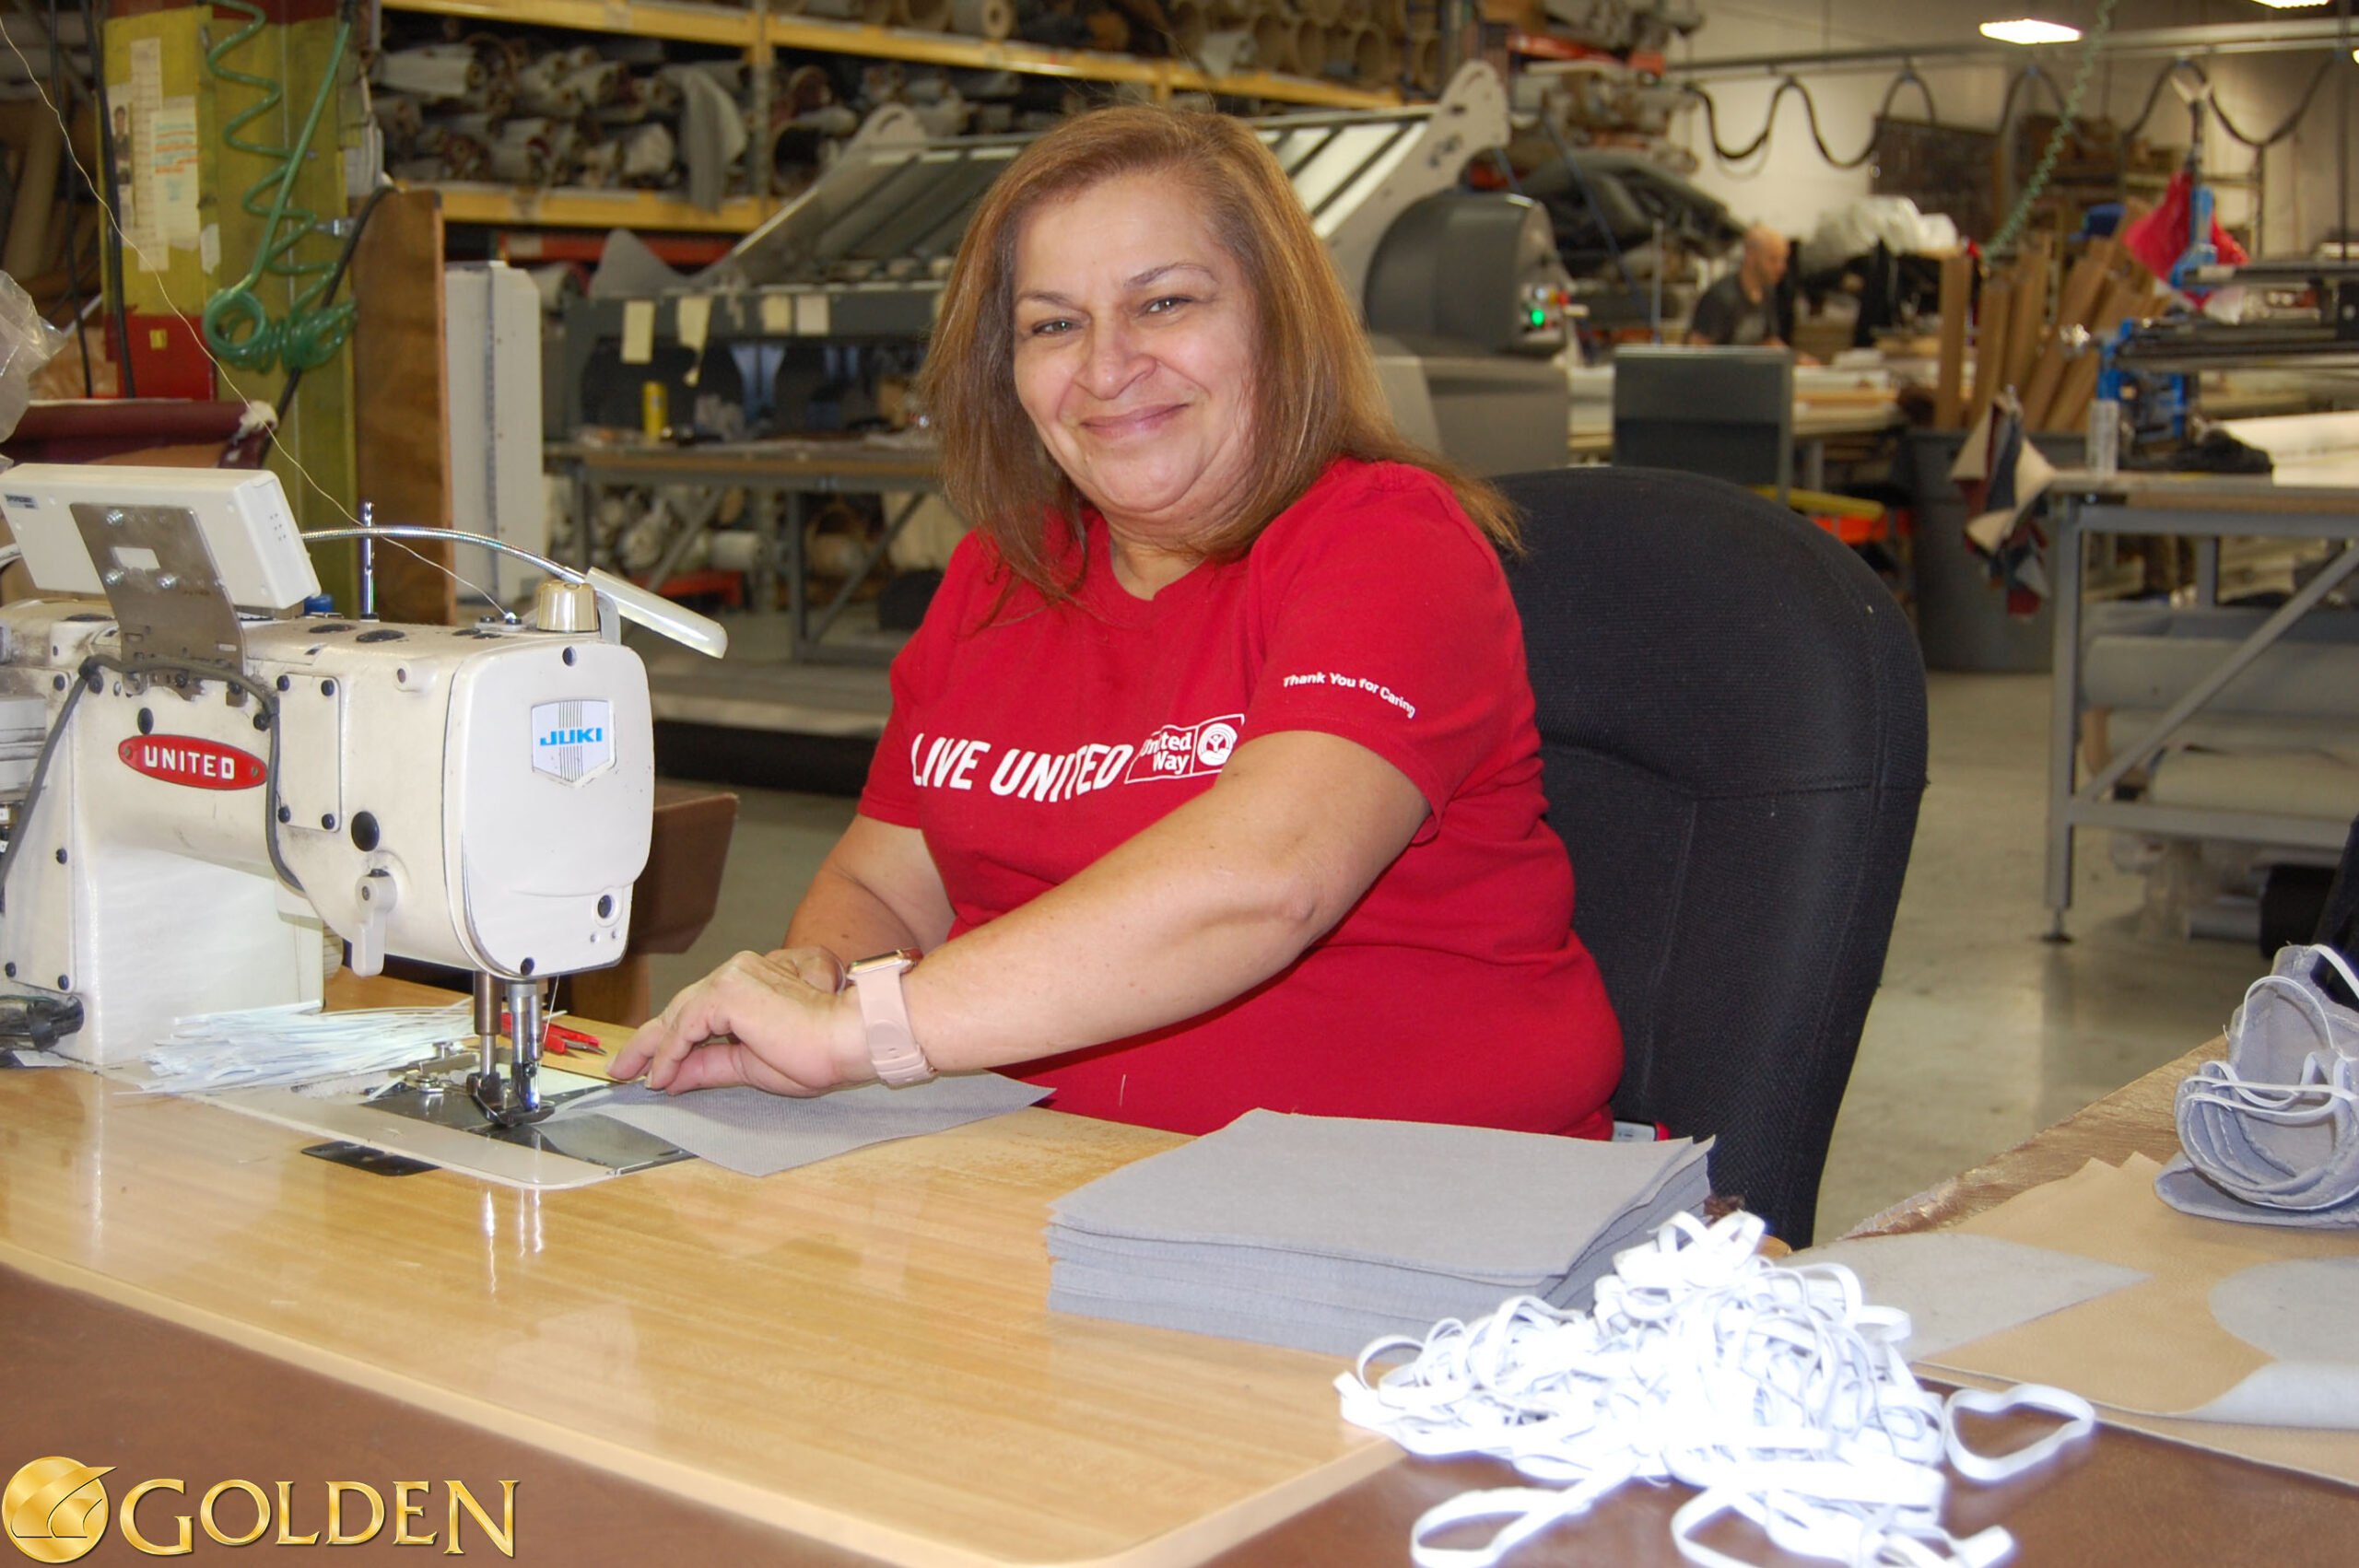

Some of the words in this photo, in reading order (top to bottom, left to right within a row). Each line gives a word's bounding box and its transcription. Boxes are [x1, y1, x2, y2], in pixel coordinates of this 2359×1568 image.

[1283, 672, 1326, 687] Thank
[1329, 672, 1357, 688] You
[1358, 677, 1380, 694] for
[1379, 686, 1416, 720] Caring
[539, 727, 604, 746] JUKI
[1138, 731, 1192, 757] Unted
[144, 744, 236, 780] UNITED
[910, 732, 992, 790] LIVE
[990, 743, 1134, 802] UNITED
[1153, 750, 1191, 775] Way
